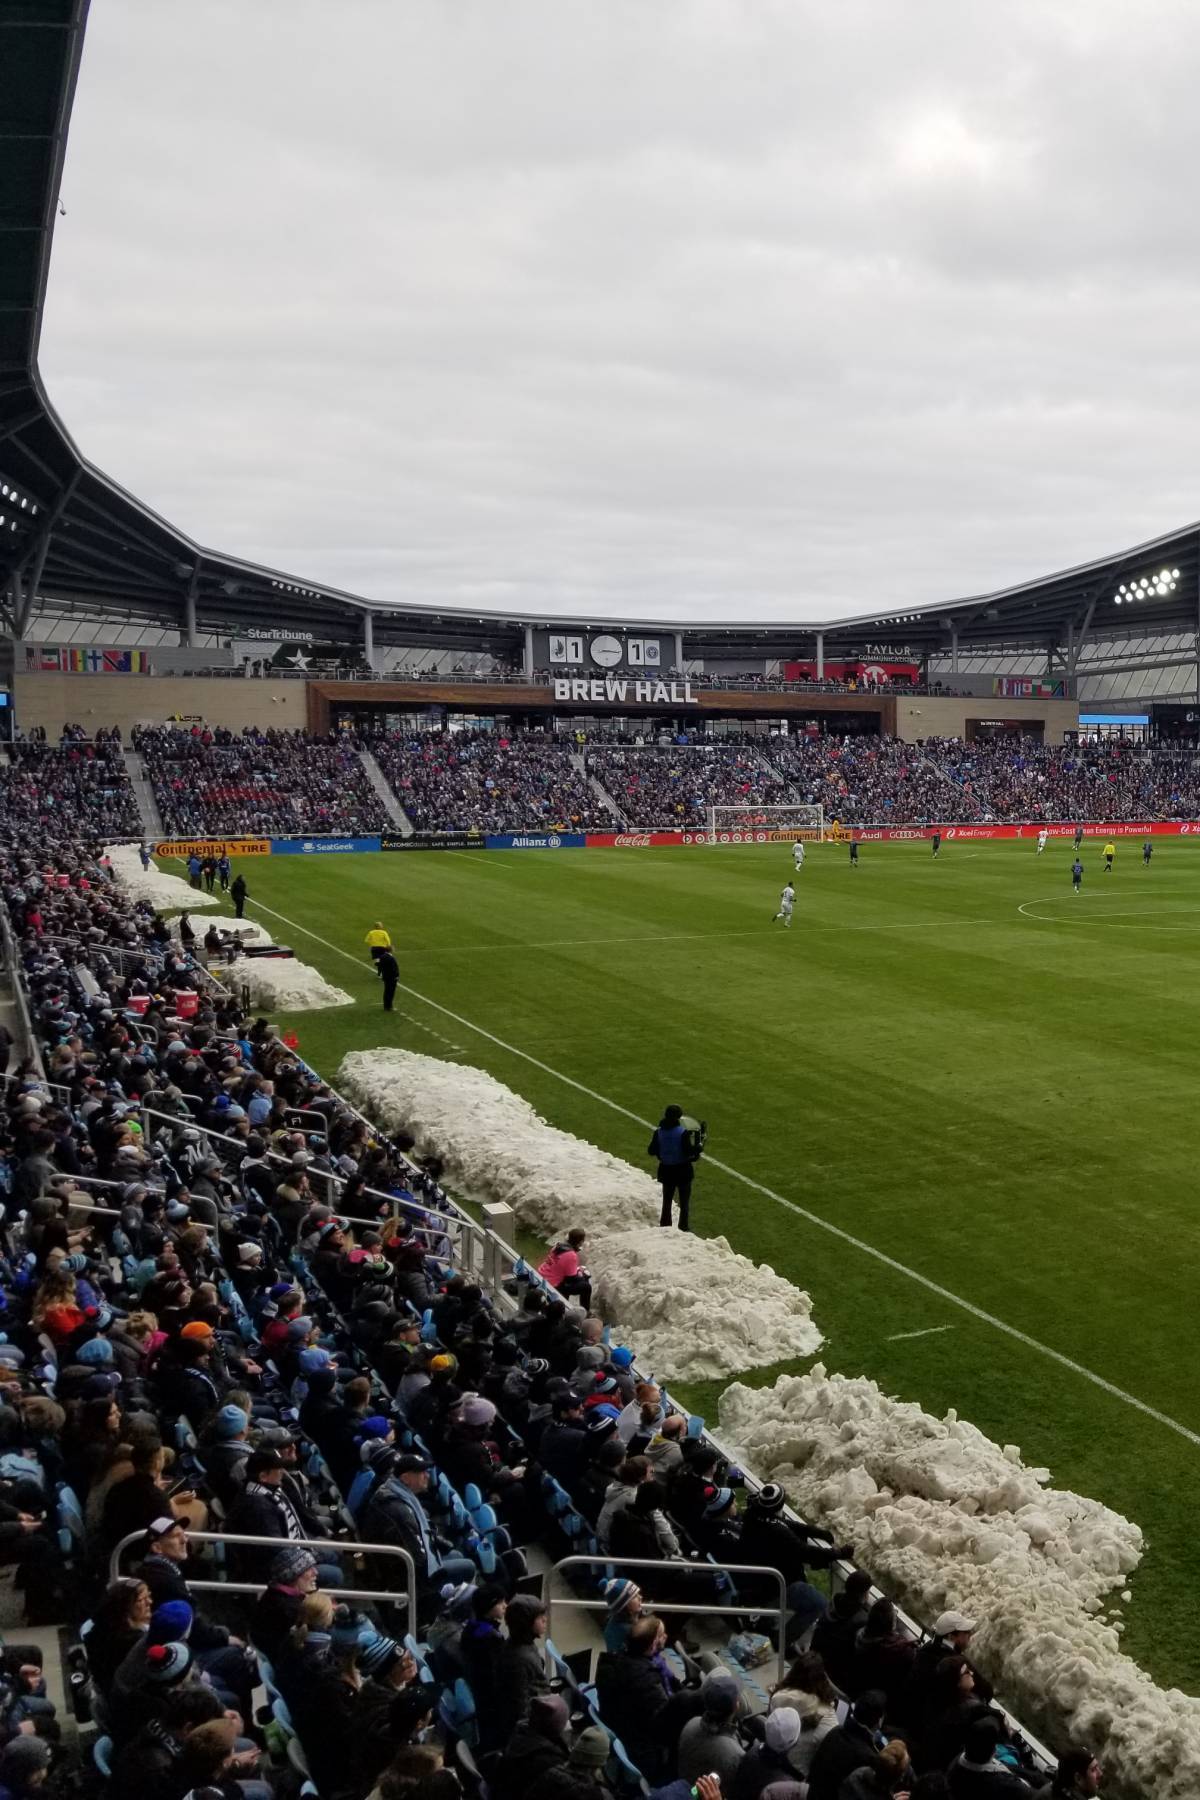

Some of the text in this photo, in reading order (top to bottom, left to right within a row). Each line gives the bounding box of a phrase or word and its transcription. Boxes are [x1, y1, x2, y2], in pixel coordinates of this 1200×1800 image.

[247, 628, 313, 640] StarTribune
[571, 642, 579, 659] 1
[631, 644, 640, 661] 1
[865, 644, 911, 656] TAYLOR
[554, 678, 698, 703] BREW HALL
[861, 831, 882, 839] Audi
[1095, 826, 1116, 836] Energy
[1124, 825, 1152, 834] Powerful
[512, 837, 547, 847] Allianz
[615, 834, 651, 847] Coca-Cola
[156, 842, 267, 857] Continental TIRE
[316, 843, 354, 851] SeatGeek
